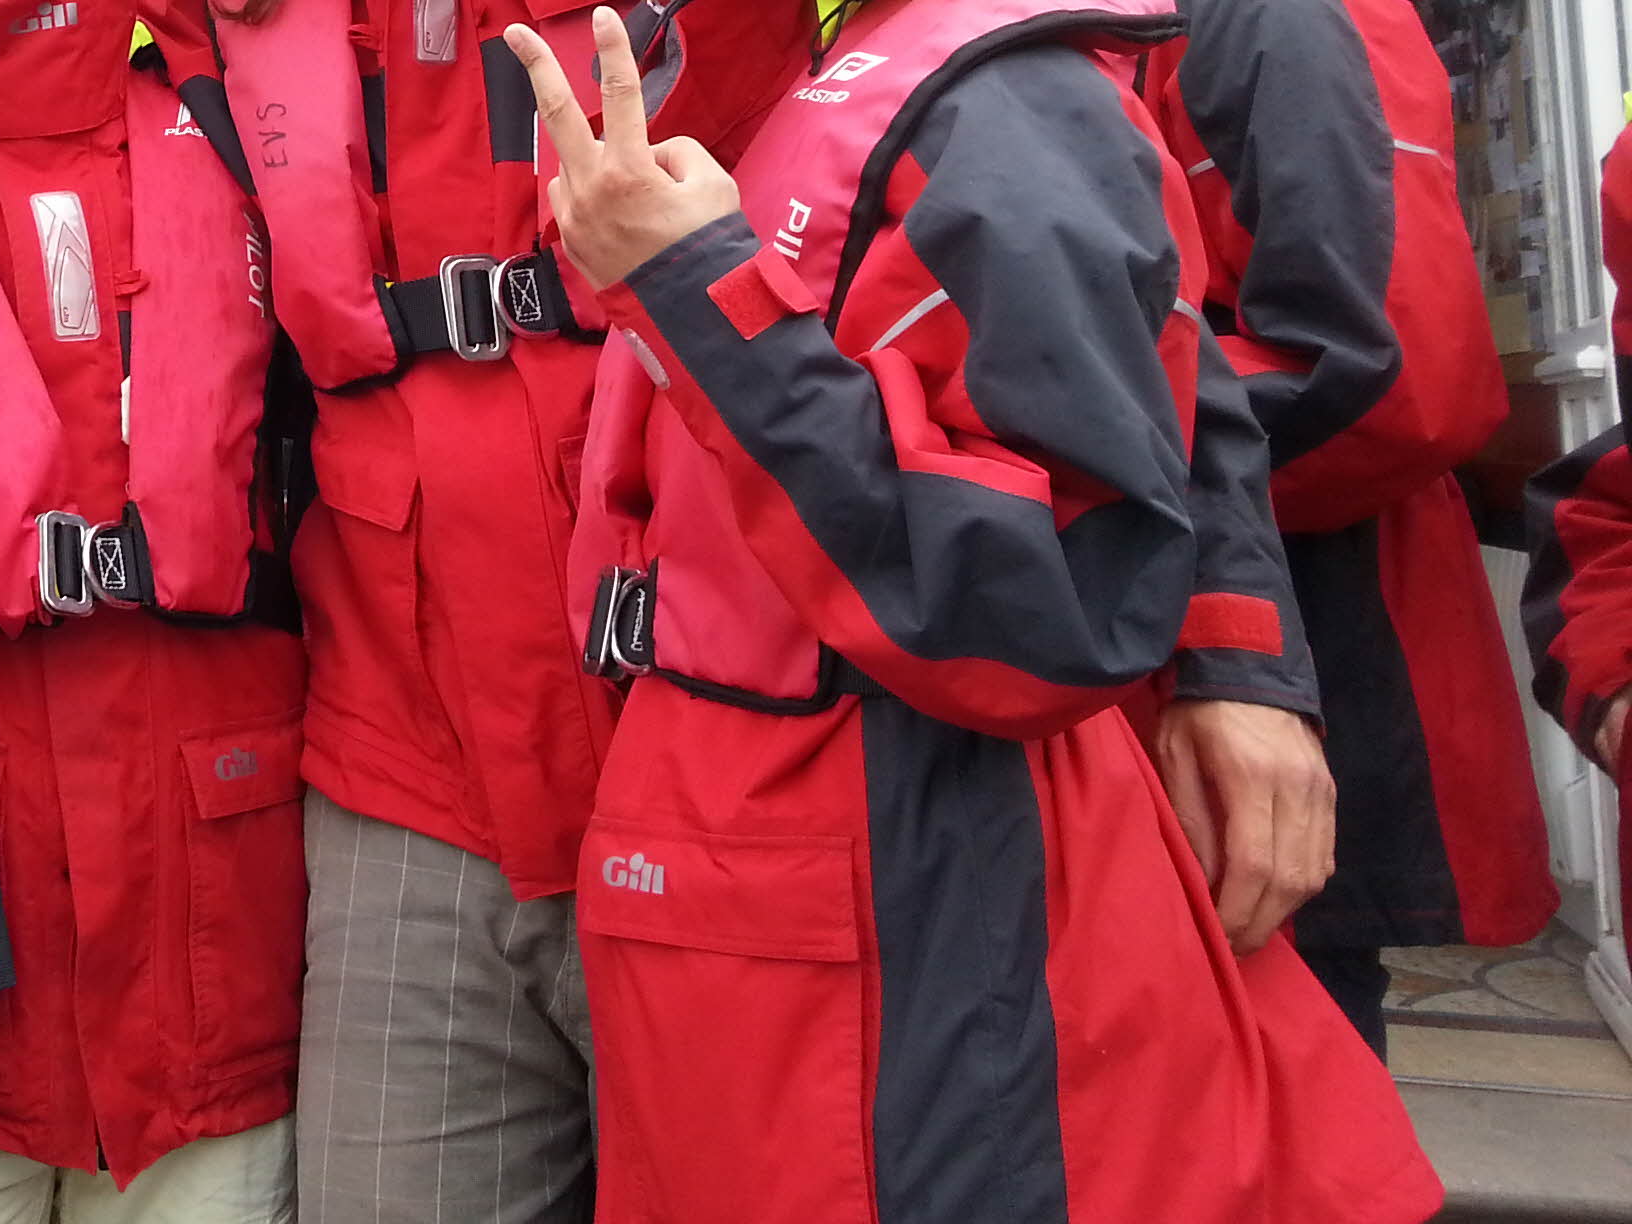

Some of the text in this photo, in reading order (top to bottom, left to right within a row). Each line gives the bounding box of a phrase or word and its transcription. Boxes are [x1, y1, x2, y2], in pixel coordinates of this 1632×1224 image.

[164, 126, 208, 139] PLAS
[256, 102, 288, 169] EVS
[215, 747, 257, 781] Gill
[601, 852, 665, 895] Gill
